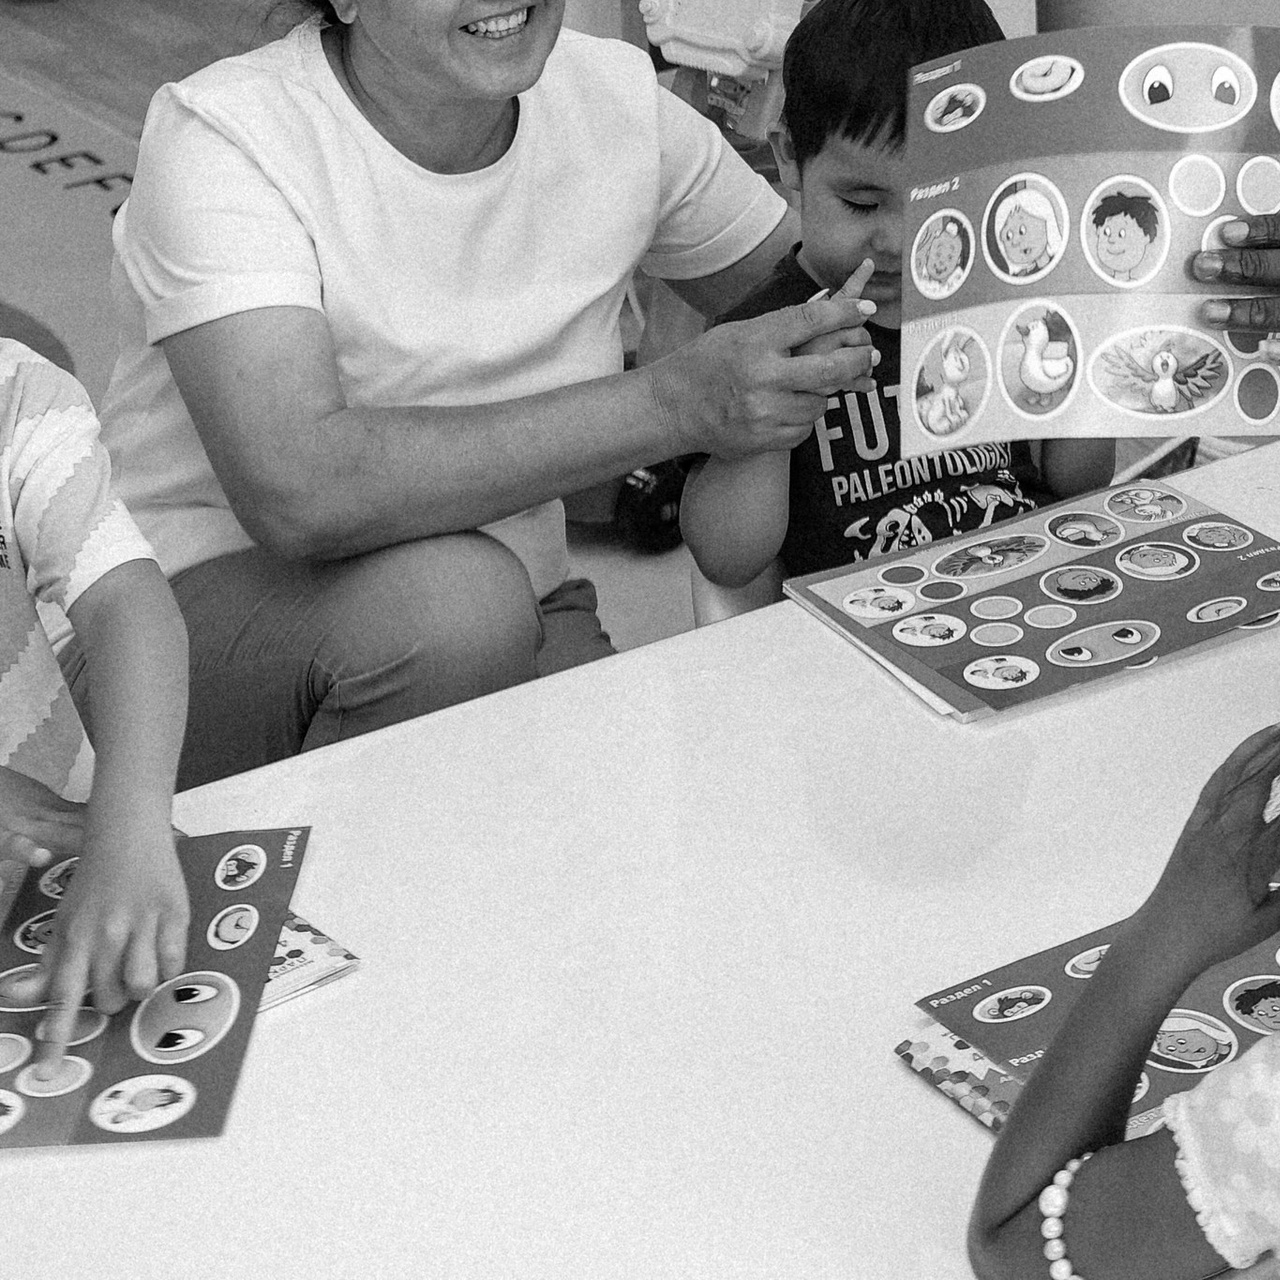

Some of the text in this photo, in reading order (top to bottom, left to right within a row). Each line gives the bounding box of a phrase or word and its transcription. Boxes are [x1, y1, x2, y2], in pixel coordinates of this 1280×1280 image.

[951, 176, 961, 191] 2
[281, 830, 303, 862] Раздел
[929, 978, 993, 1008] Раздел 1
